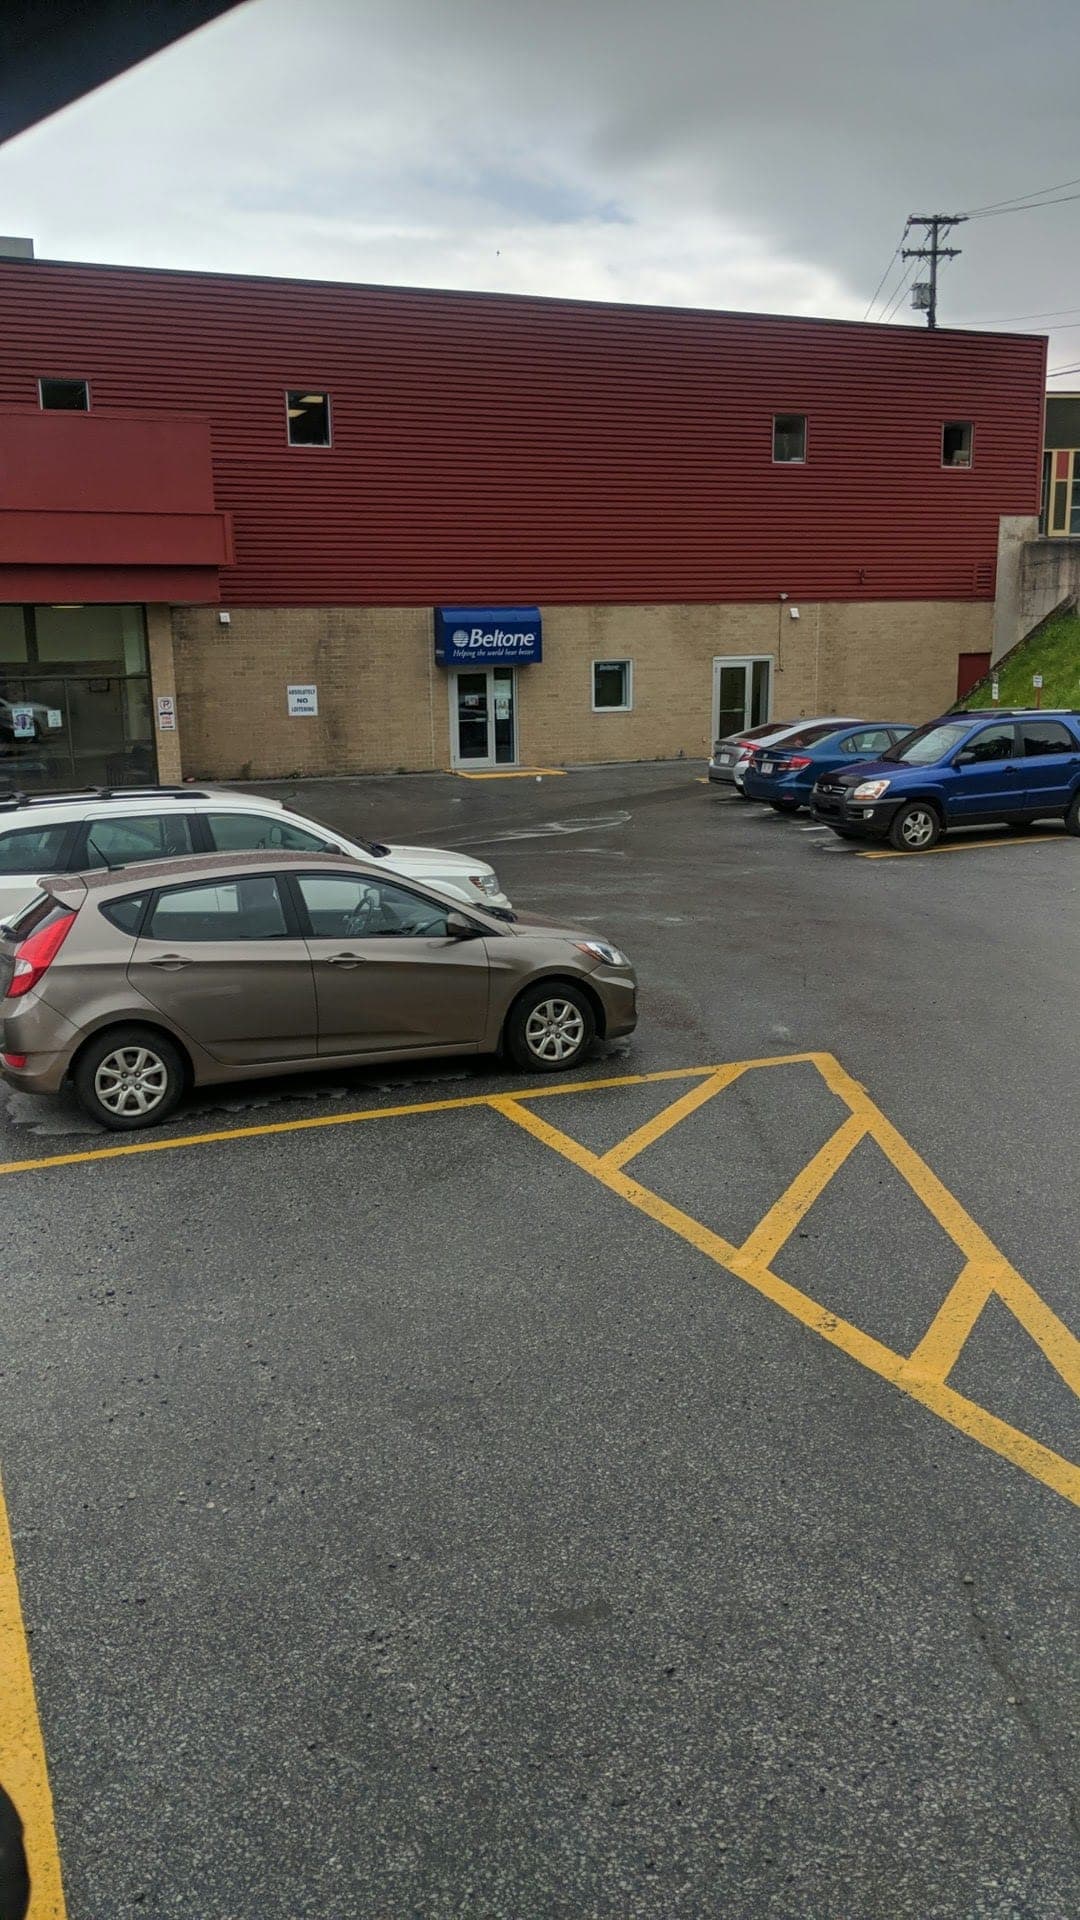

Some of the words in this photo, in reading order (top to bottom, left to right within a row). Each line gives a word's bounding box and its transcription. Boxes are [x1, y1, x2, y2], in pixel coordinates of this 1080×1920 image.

[469, 628, 535, 648] Beltone
[453, 649, 476, 659] Helping
[477, 648, 486, 657] the
[487, 648, 504, 657] world
